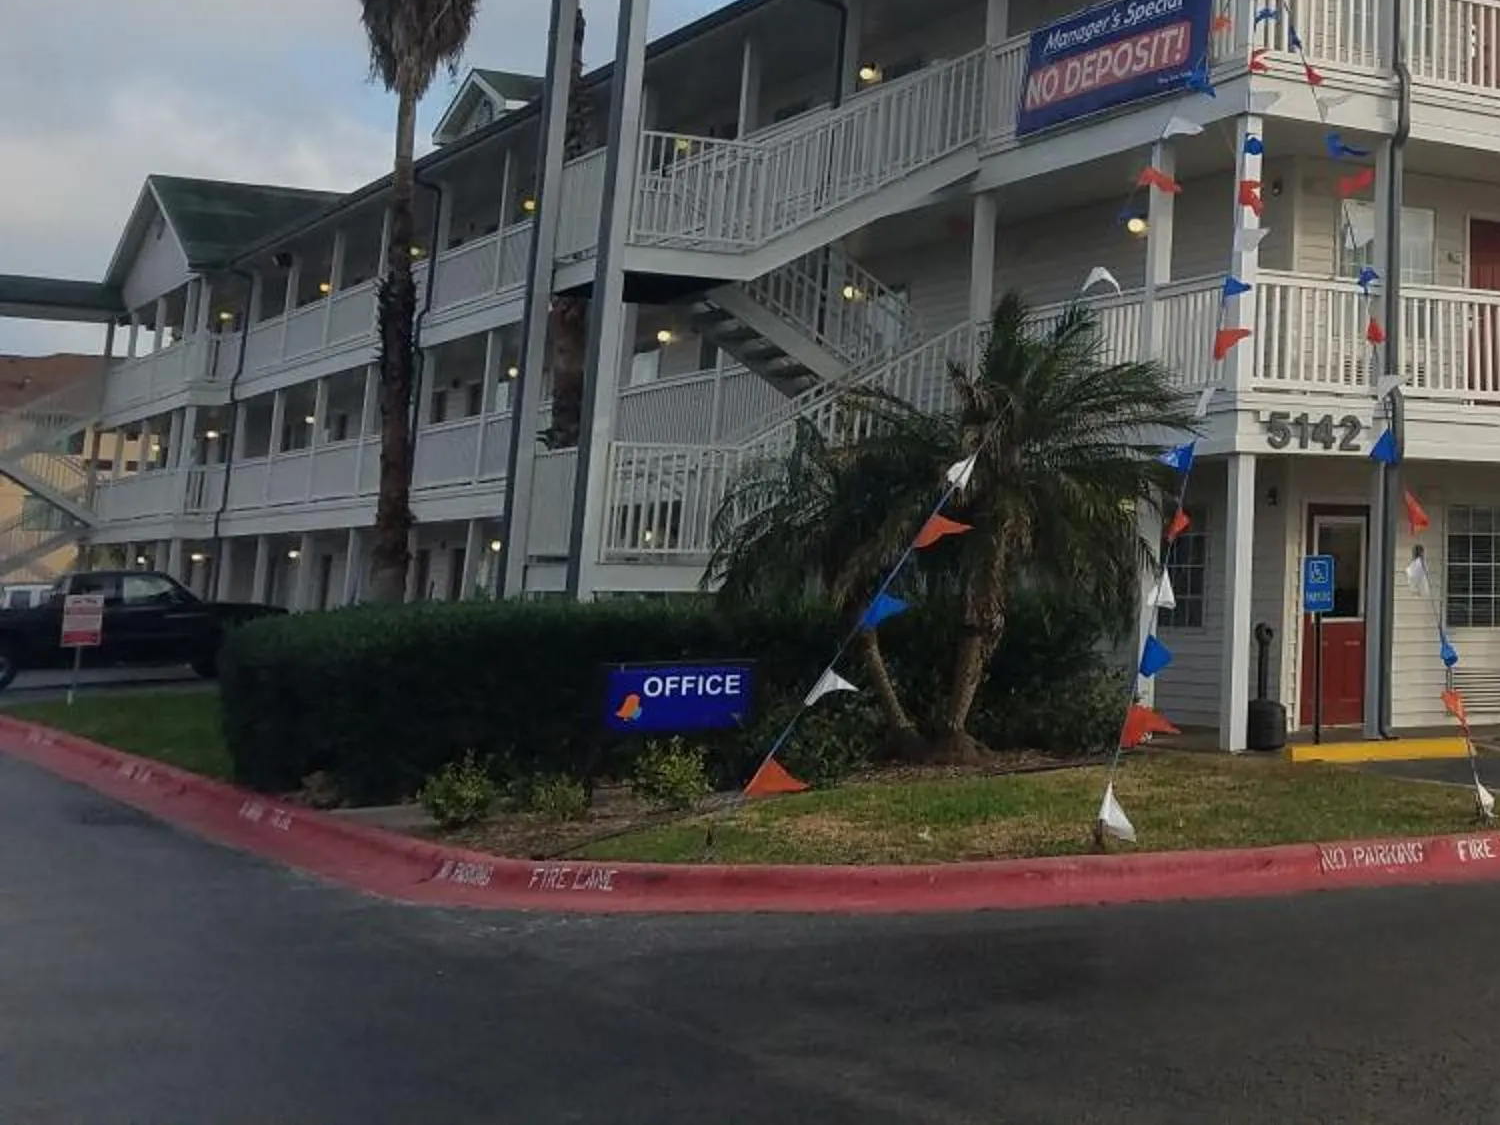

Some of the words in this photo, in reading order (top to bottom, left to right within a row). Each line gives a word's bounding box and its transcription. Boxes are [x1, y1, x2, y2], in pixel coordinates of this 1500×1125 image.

[1044, 6, 1120, 53] Manager's
[1025, 69, 1059, 108] NO
[1064, 26, 1186, 94] DEPOSIT!
[1266, 411, 1361, 452] 5142
[643, 674, 741, 697] OFFICE
[1321, 847, 1346, 872] NO
[1354, 842, 1424, 868] PARKING
[1456, 836, 1496, 862] FIRE
[528, 867, 568, 889] FIRE
